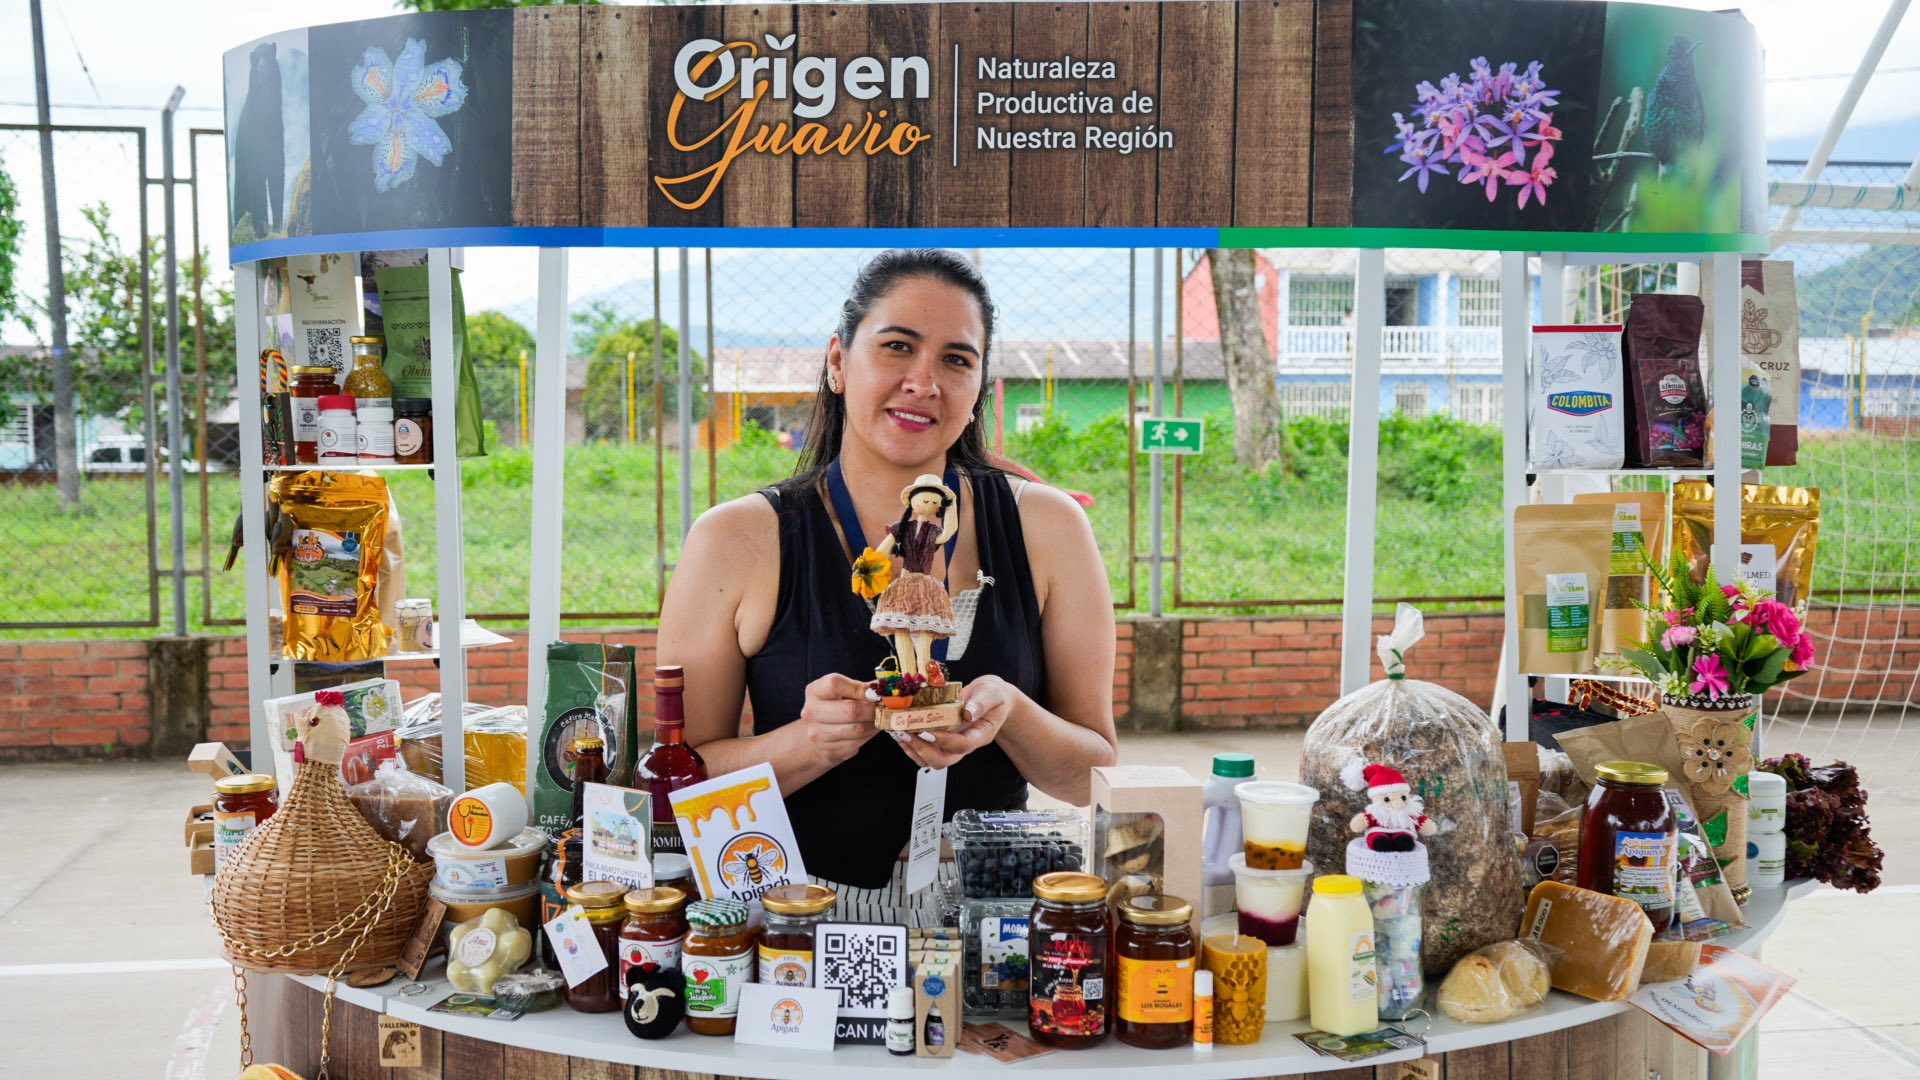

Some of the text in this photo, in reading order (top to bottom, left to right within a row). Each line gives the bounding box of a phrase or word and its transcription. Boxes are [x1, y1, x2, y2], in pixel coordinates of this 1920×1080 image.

[674, 34, 931, 118] Origen
[977, 56, 1116, 80] Naturaleza
[977, 91, 1153, 116] Productiva de
[654, 41, 931, 210] Guavio
[977, 124, 1174, 154] Nuestra Región
[1759, 361, 1790, 371] CRUZ
[1551, 394, 1610, 408] COLOMBITA
[540, 813, 567, 825] CAFÉ
[585, 861, 648, 880] FINCA AGROTURÍSTICA
[731, 876, 791, 902] Apigach
[688, 991, 718, 1003] Jalapeño
[771, 1023, 800, 1035] Apigach
[836, 1024, 867, 1039] CAN
[872, 1024, 885, 1039] M
[1402, 1062, 1428, 1077] CUMBIA
